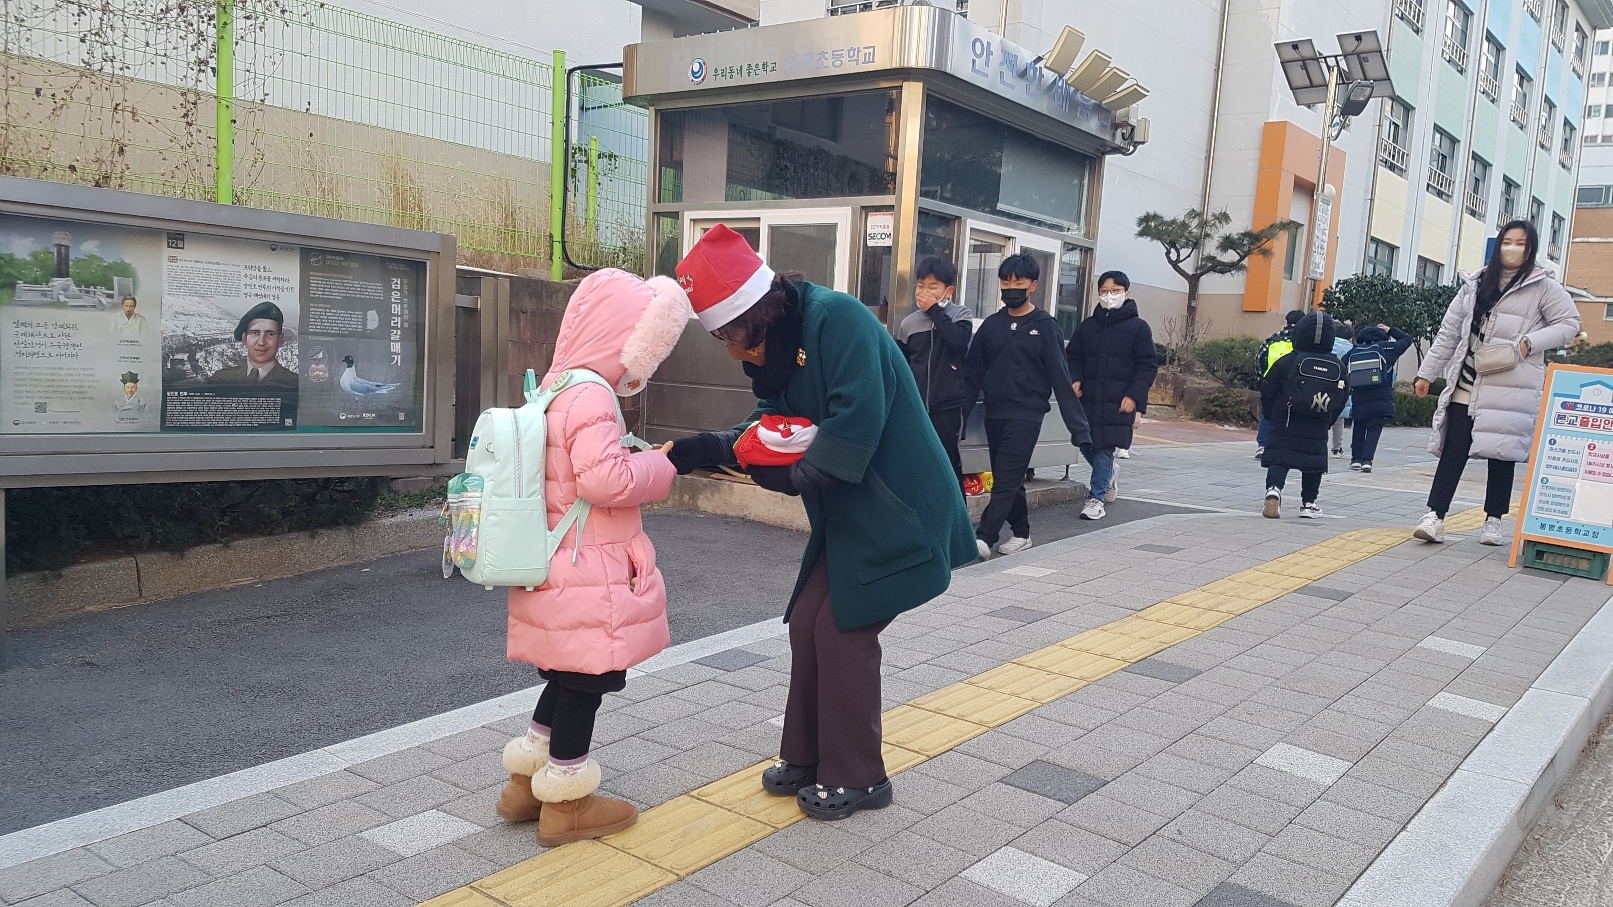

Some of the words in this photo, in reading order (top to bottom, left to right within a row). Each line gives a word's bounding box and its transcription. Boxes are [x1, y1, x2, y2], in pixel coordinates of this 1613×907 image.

[712, 64, 743, 82] 우리동네
[745, 61, 778, 77] 좋은학교
[167, 239, 184, 248] 12월
[867, 232, 892, 241] SECOM
[390, 277, 402, 367] 검은머리갈매기
[1310, 391, 1331, 413] NY
[1575, 403, 1597, 413] 코로나
[1598, 405, 1608, 414] 19
[1539, 521, 1600, 539] 봉명초등학교장
